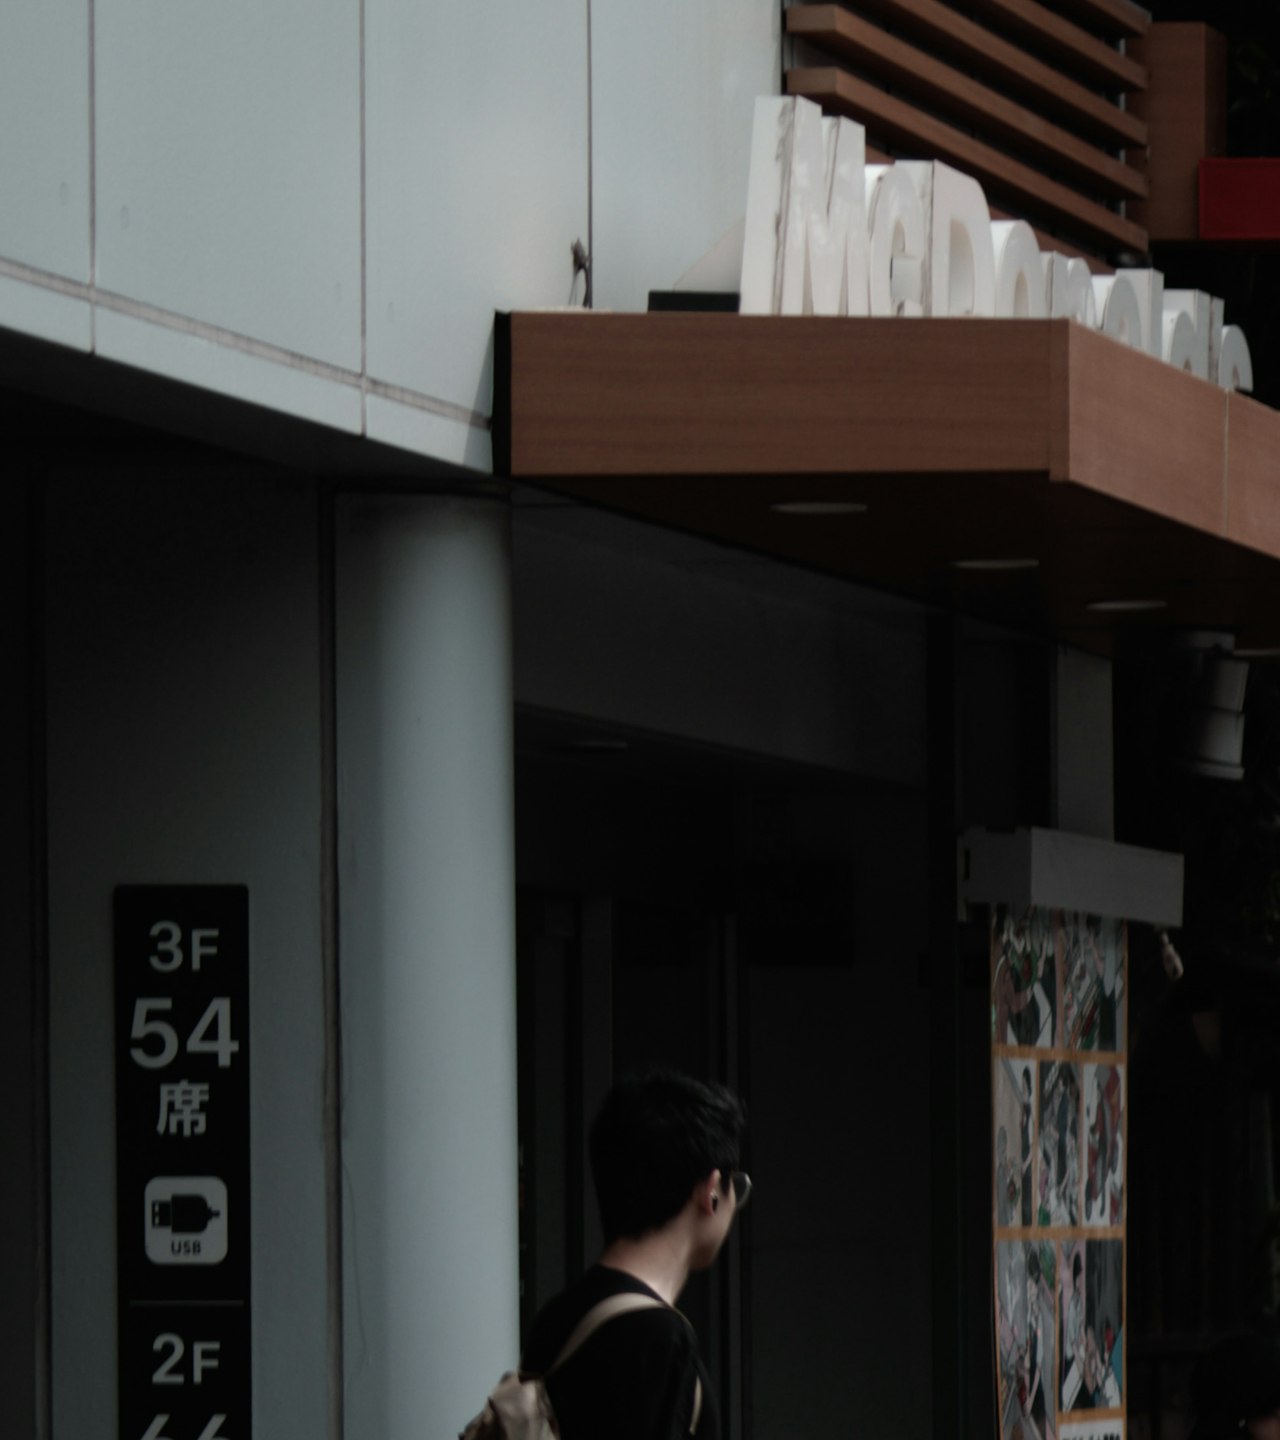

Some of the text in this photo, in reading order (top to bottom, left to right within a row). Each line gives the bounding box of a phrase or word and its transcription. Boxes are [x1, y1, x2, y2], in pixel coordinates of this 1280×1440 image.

[149, 919, 221, 974] 3F
[128, 995, 241, 1071] 54
[155, 1077, 211, 1139] 席
[171, 1239, 202, 1256] USB
[151, 1331, 222, 1386] 2F
